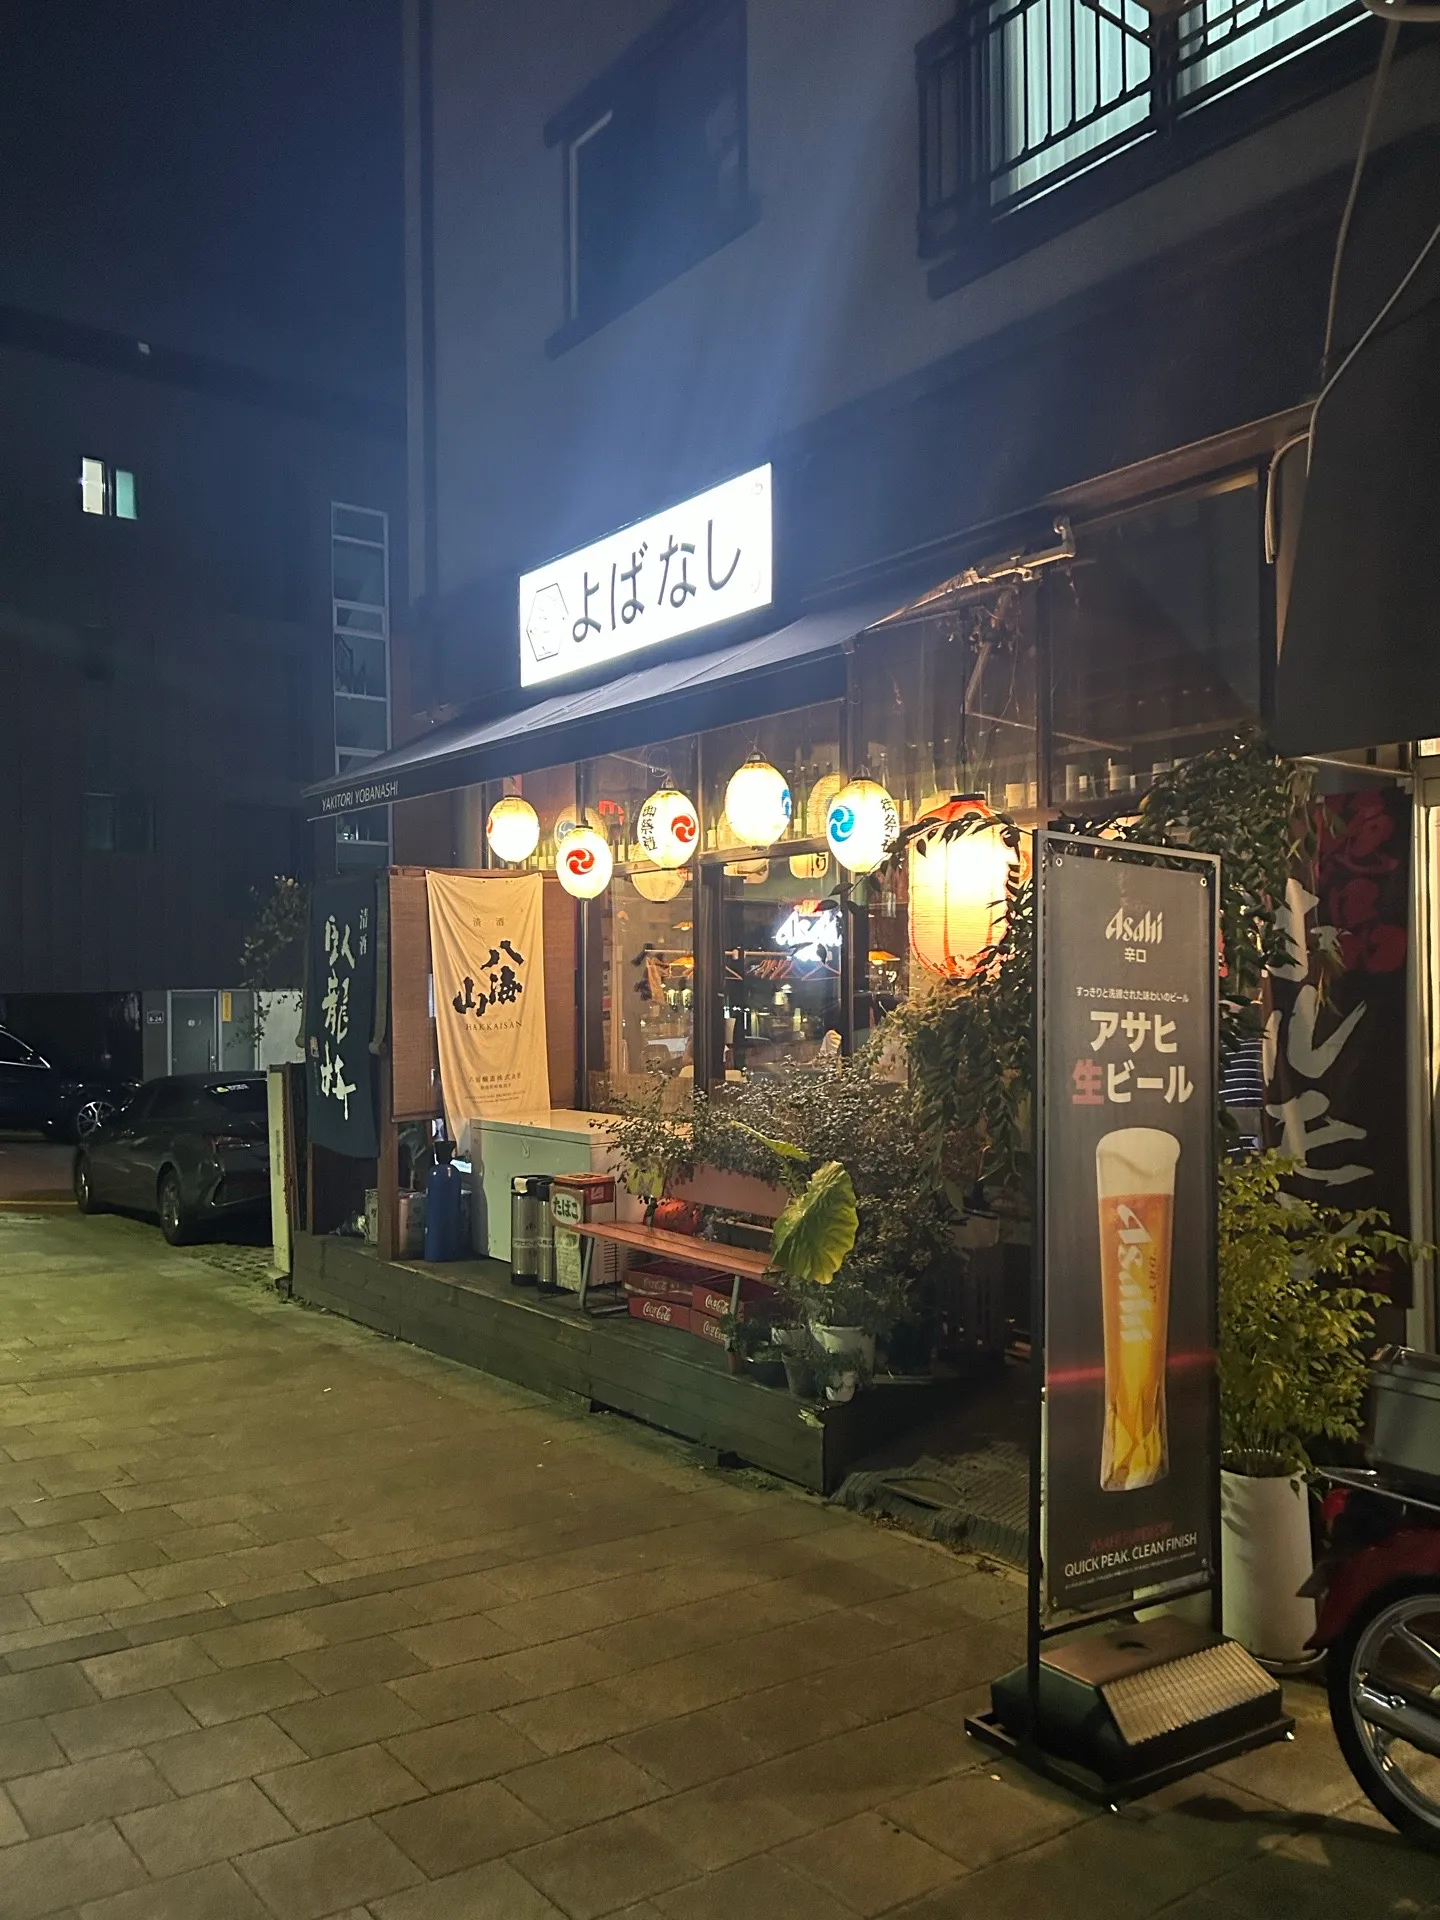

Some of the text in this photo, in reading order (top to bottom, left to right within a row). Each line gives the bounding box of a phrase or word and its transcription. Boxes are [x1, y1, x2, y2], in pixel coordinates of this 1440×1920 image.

[572, 519, 741, 643] よばなし
[322, 781, 398, 812] YAKITORI YOBANASHI
[1105, 907, 1163, 944] Asahi
[1124, 947, 1147, 963] 辛口
[452, 939, 525, 1017] 八海山
[465, 1021, 523, 1031] HAKKAISAN
[1090, 1010, 1177, 1053] アサヒ
[1072, 1058, 1194, 1105] 生ビール
[552, 1197, 579, 1220] たばこ
[1117, 1203, 1153, 1344] Asahi
[642, 1301, 672, 1322] Coca-Cola
[1064, 1556, 1099, 1577] QUICK
[1101, 1549, 1131, 1568] PEAK.
[1132, 1540, 1164, 1560] CLEAN
[1166, 1532, 1197, 1552] FINISH
